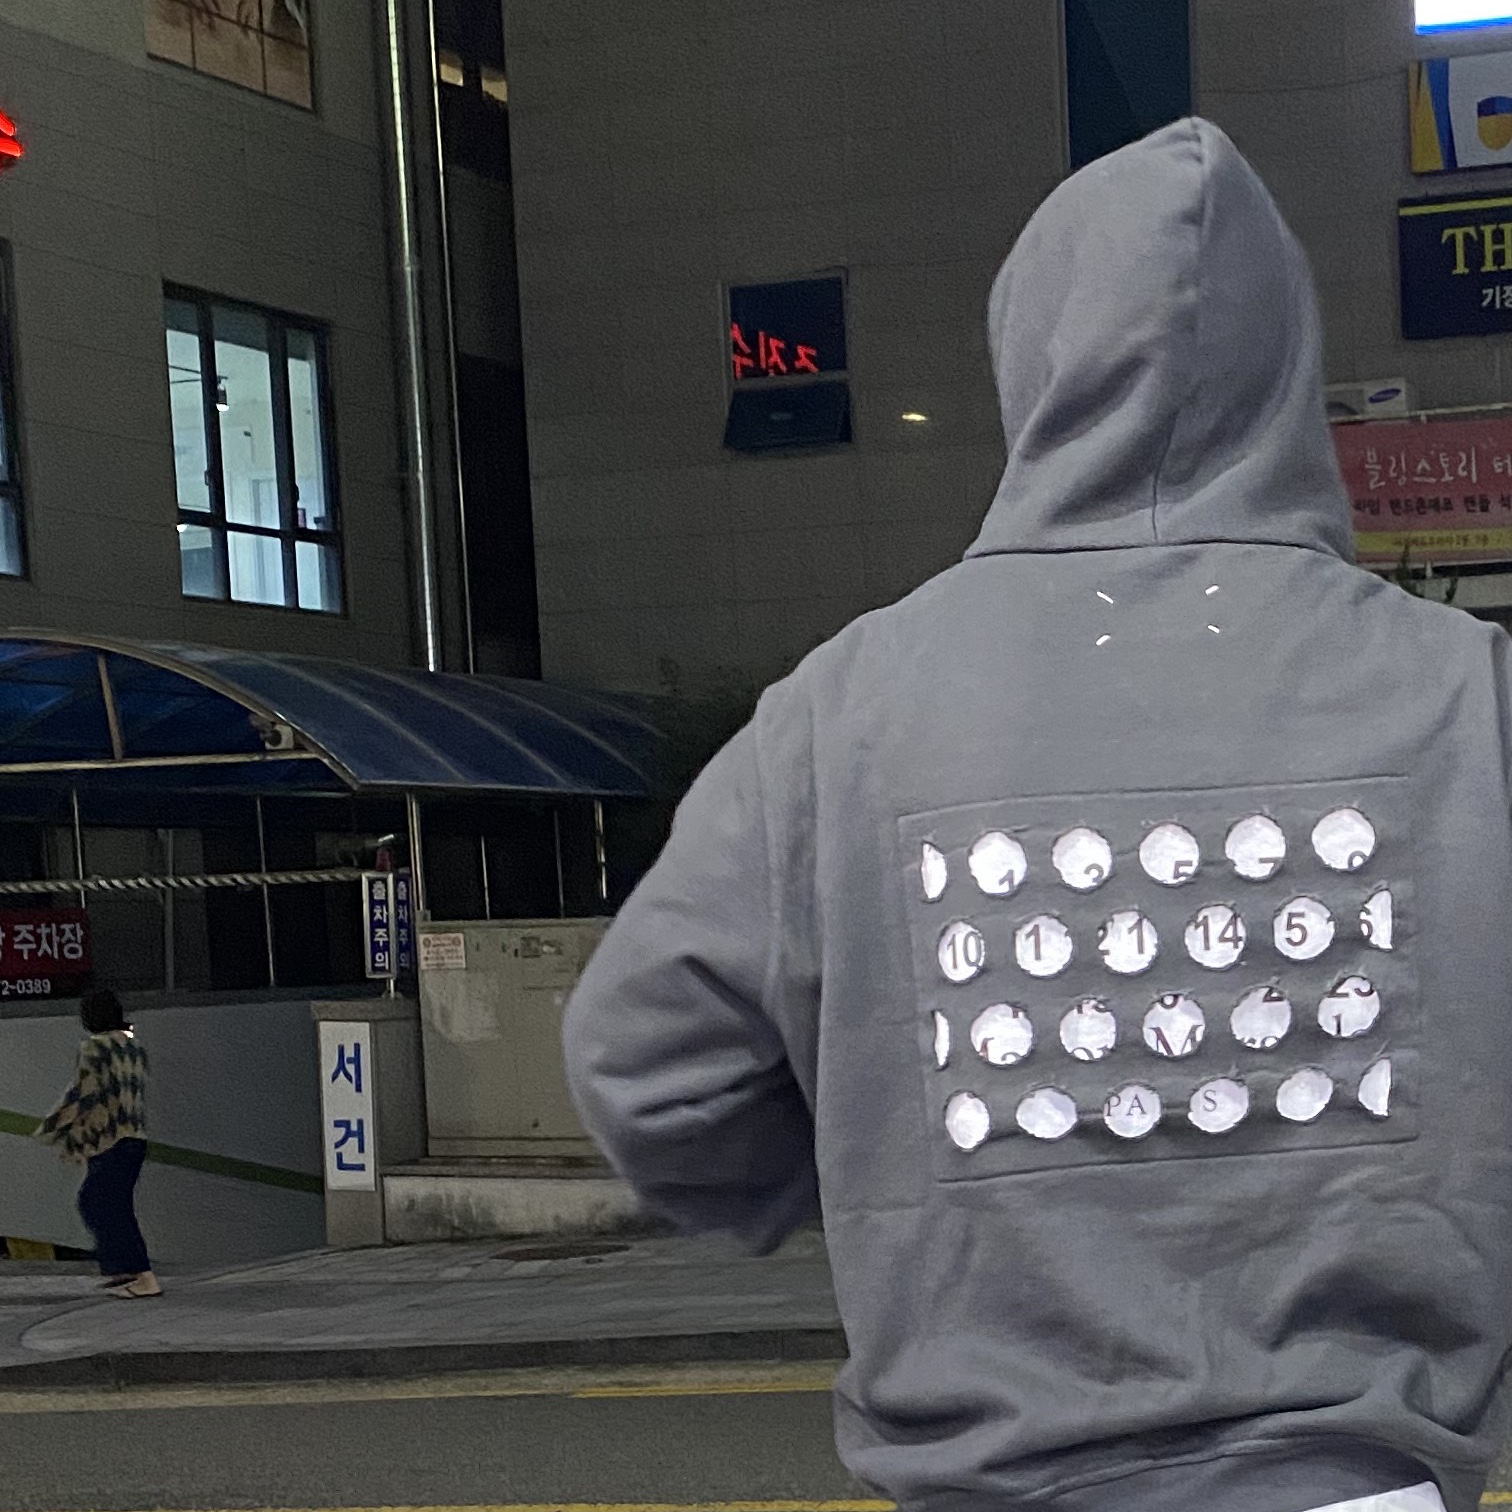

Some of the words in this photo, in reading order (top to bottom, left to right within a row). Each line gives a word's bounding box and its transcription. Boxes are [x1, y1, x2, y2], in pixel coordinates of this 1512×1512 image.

[13, 923, 84, 959] 주차장
[946, 930, 983, 970] 10
[1024, 923, 1043, 961] 1
[1194, 912, 1243, 951] 14
[1285, 911, 1308, 947] 5
[331, 1042, 366, 1172] 서건
